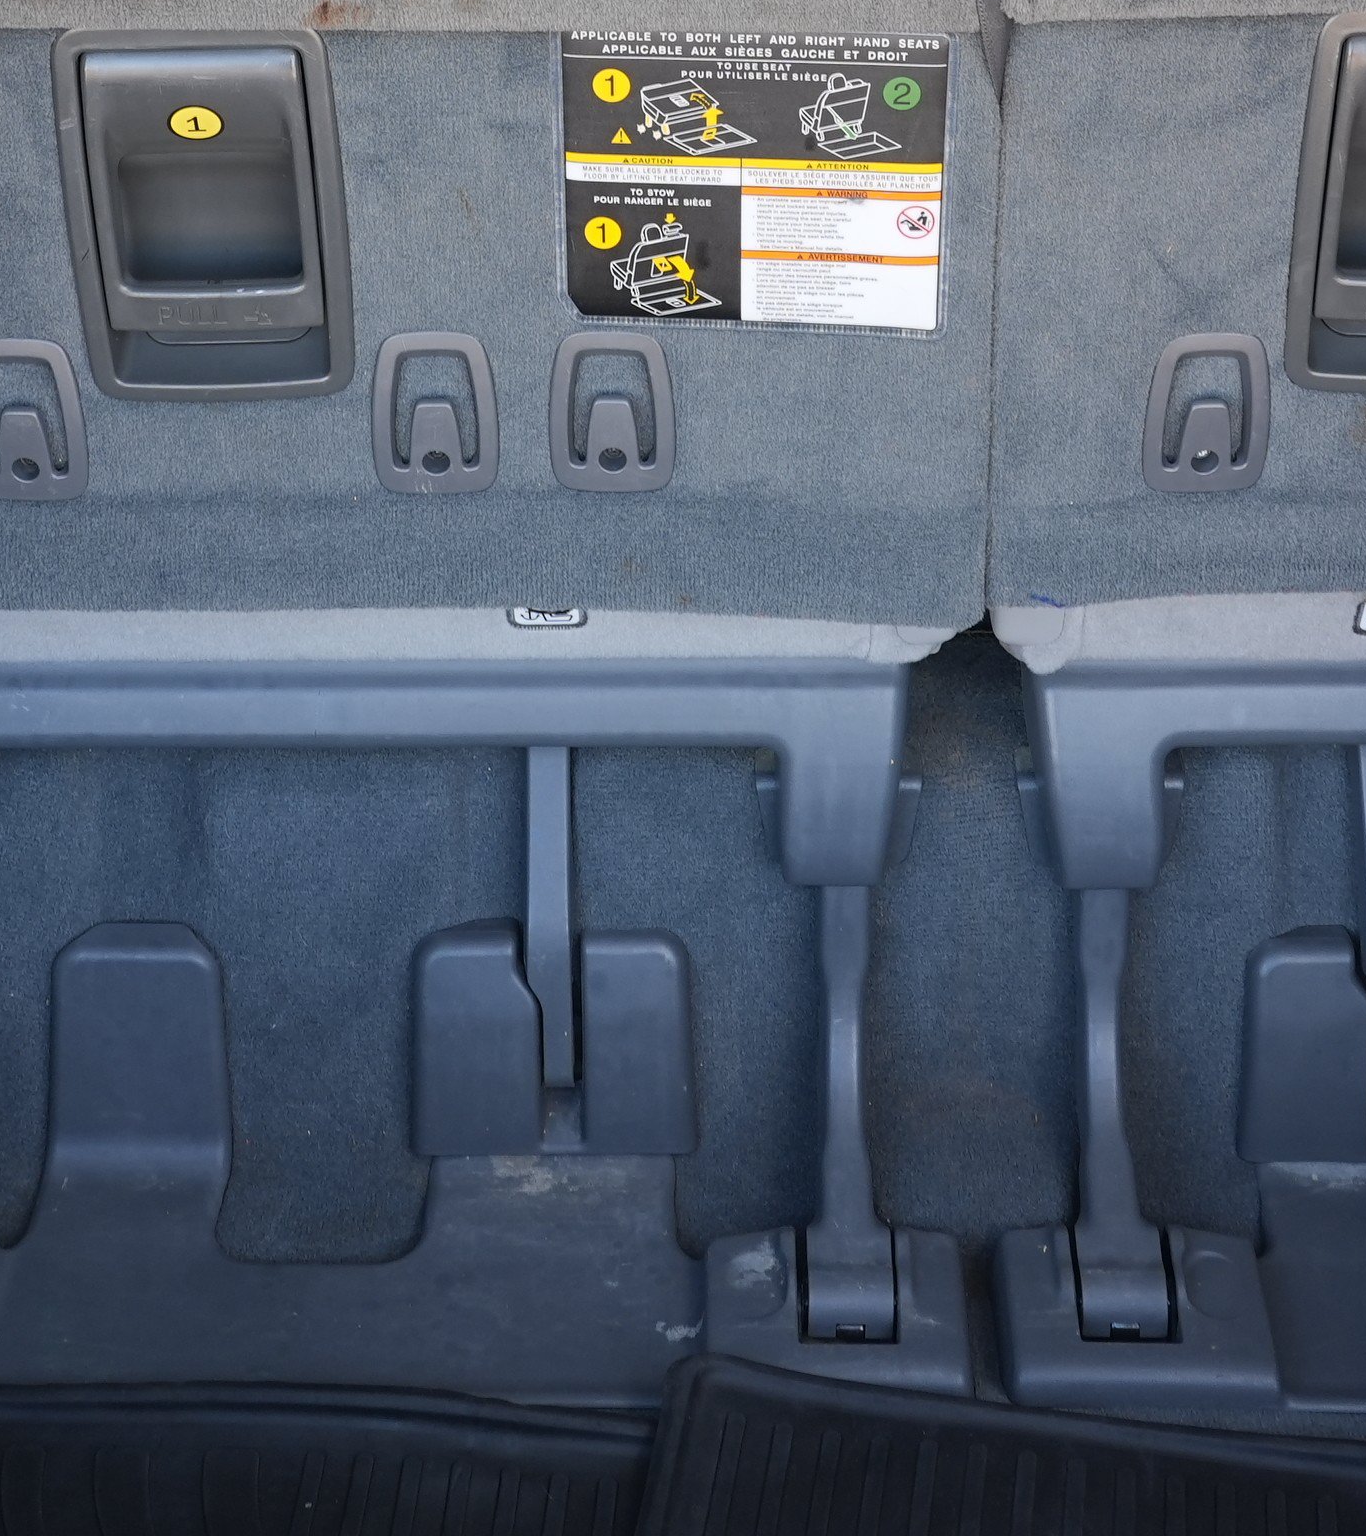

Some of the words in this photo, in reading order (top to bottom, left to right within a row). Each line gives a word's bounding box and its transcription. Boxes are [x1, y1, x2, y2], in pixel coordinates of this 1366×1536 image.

[571, 31, 652, 41] APPLICABLE
[660, 32, 677, 42] TO
[686, 33, 721, 43] BOTH
[730, 34, 761, 45] LEFT
[770, 35, 796, 45] AND
[805, 36, 845, 46] RIGHT
[854, 38, 890, 47] HAND
[899, 39, 940, 49] SEATS
[602, 45, 683, 55] APPLICABLE
[691, 47, 716, 56] AUX
[724, 46, 772, 58] SIÈGES
[781, 49, 835, 59] GAUCHE
[844, 51, 859, 60] ET
[868, 51, 908, 61] DROIT
[716, 62, 732, 70] TO
[735, 63, 758, 71] USE
[762, 64, 792, 72] SEAT
[681, 70, 713, 79] POUR
[716, 71, 771, 80] UTILISER
[774, 72, 788, 81] LE
[792, 71, 828, 82] SIÈGE
[604, 75, 616, 97] 1
[892, 82, 911, 107] 2
[186, 116, 207, 132] 1
[631, 157, 673, 165] CAUTION
[630, 188, 643, 196] TO
[648, 189, 675, 197] STOW
[827, 190, 868, 199] WARNING
[594, 196, 620, 204] POUR
[624, 197, 664, 205] RANGER
[668, 198, 679, 206] LE
[683, 197, 712, 207] SIÈGE
[596, 223, 606, 243] 1
[808, 252, 883, 264] AVERTISSEMENT
[158, 307, 228, 325] PULL
